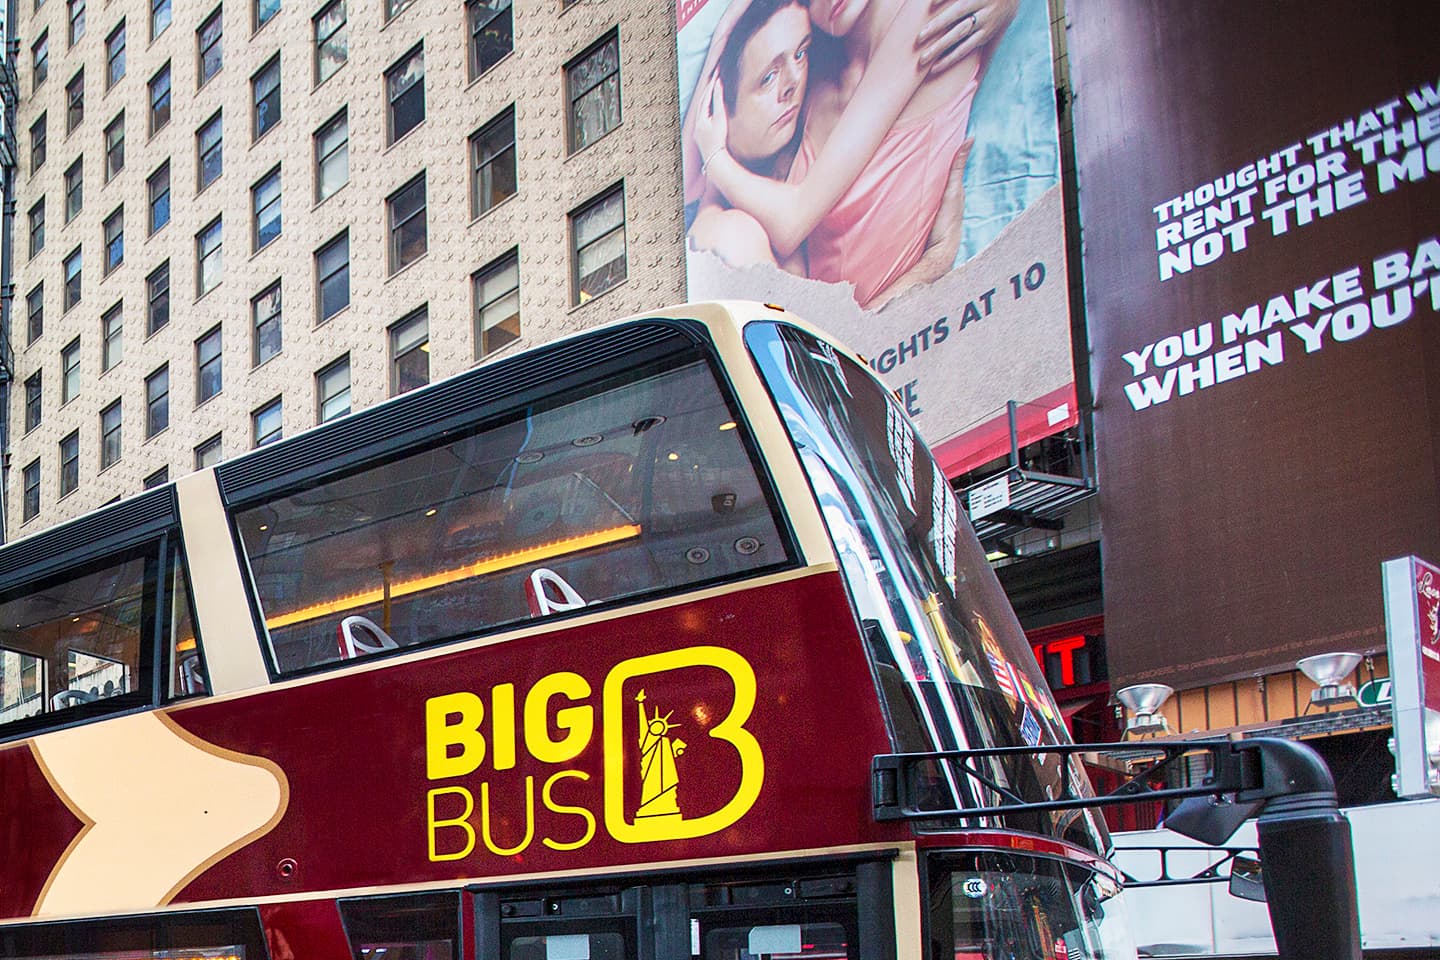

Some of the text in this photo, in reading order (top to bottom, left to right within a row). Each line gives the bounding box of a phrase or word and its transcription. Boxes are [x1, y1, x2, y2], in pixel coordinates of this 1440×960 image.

[1153, 143, 1302, 223] THOUGHT
[1307, 99, 1401, 157] THAT
[1156, 187, 1257, 251] RENT
[1264, 151, 1347, 206] FOR
[1159, 216, 1255, 282] NOT
[1262, 170, 1367, 236] THE
[959, 287, 998, 333] AT
[1009, 262, 1047, 302] 10
[1122, 322, 1212, 376] YOU
[1222, 266, 1364, 345] MAKE
[1124, 276, 1440, 411] WHEN YOU'
[426, 671, 594, 780] BIG
[427, 769, 596, 862] BUS
